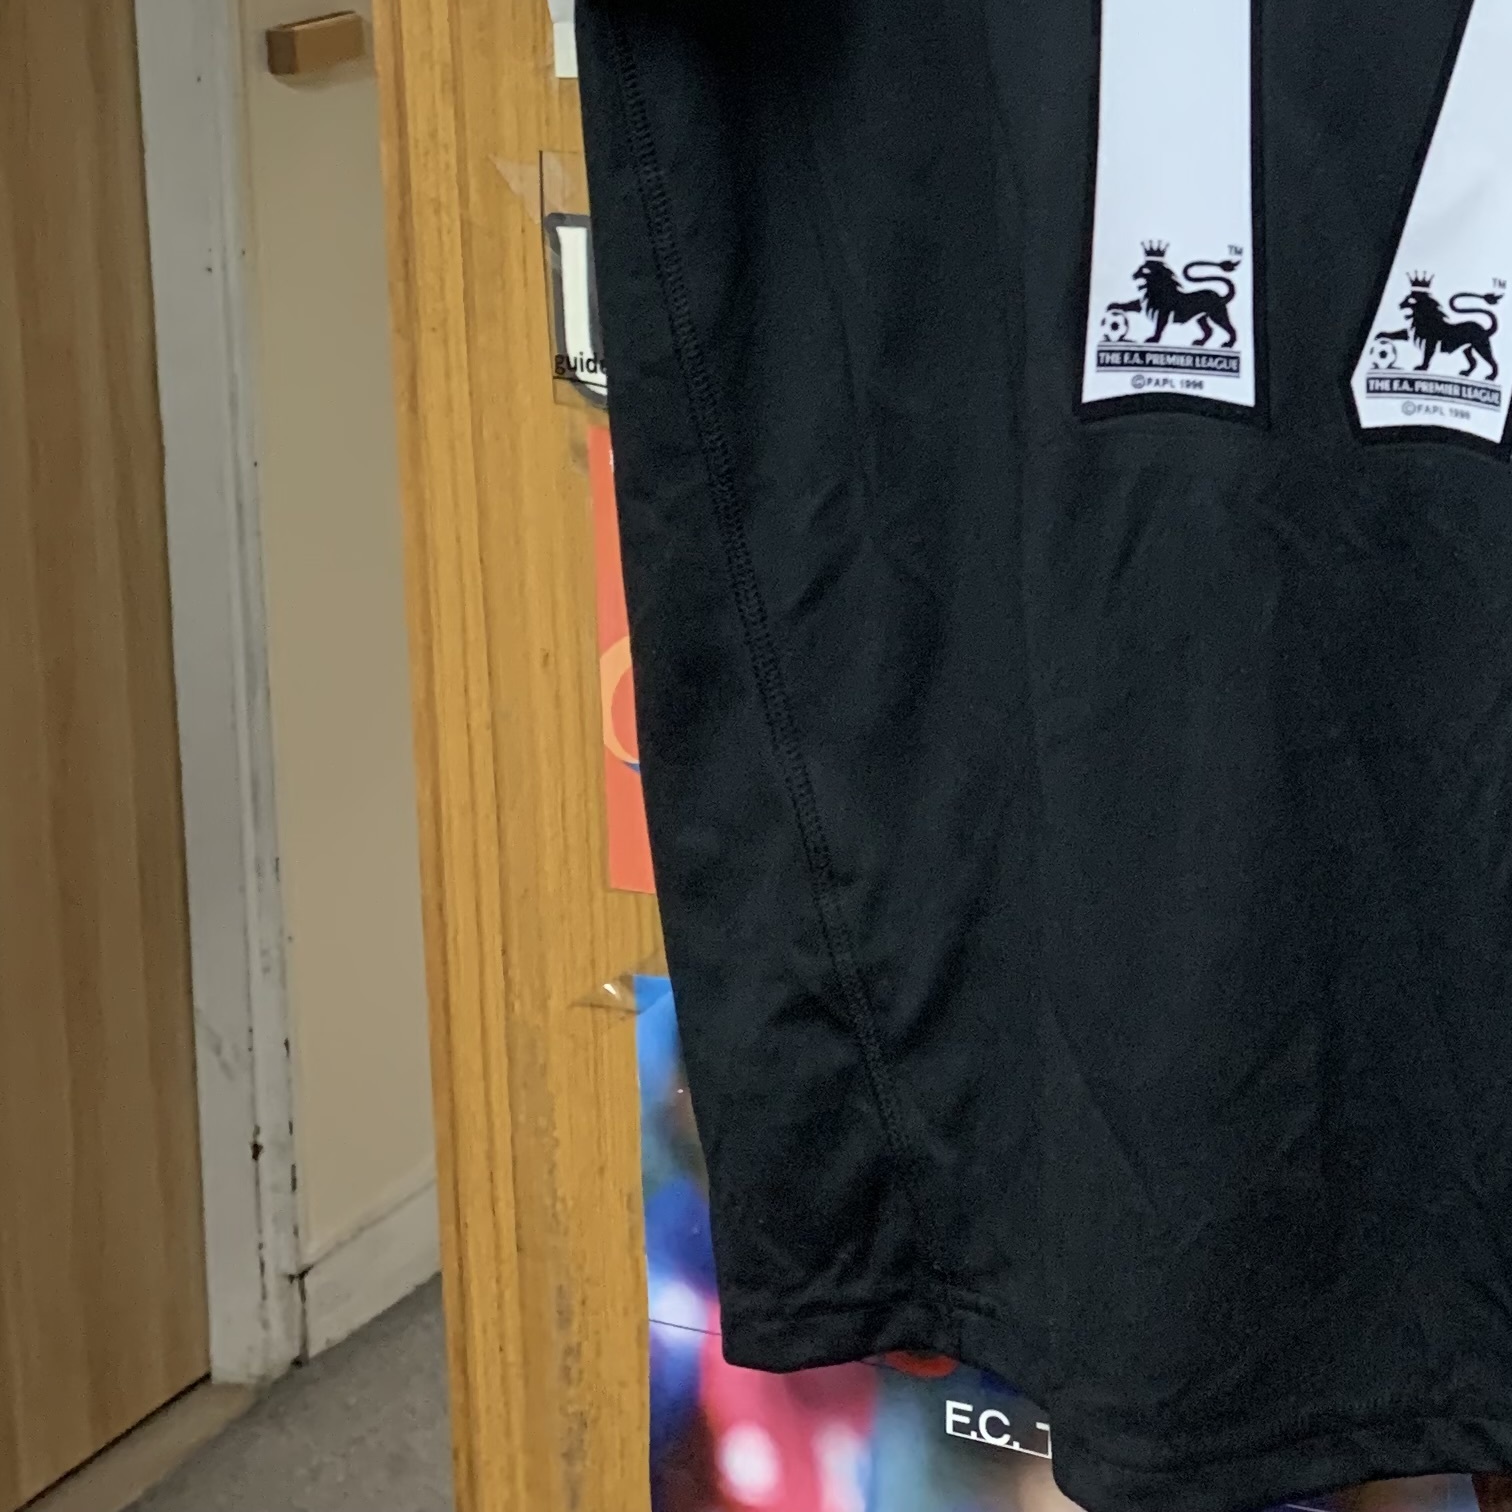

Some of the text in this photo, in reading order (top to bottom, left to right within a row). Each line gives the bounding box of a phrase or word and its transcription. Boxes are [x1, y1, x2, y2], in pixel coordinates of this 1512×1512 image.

[1227, 244, 1243, 256] TM
[1492, 277, 1507, 289] TM
[1099, 352, 1238, 370] THE F.A. PREMIER LEAGUE
[1368, 379, 1391, 392] THE
[1414, 381, 1461, 397] PREMIER
[1462, 386, 1500, 404] LEAGUE
[945, 1399, 1020, 1449] F.C.
